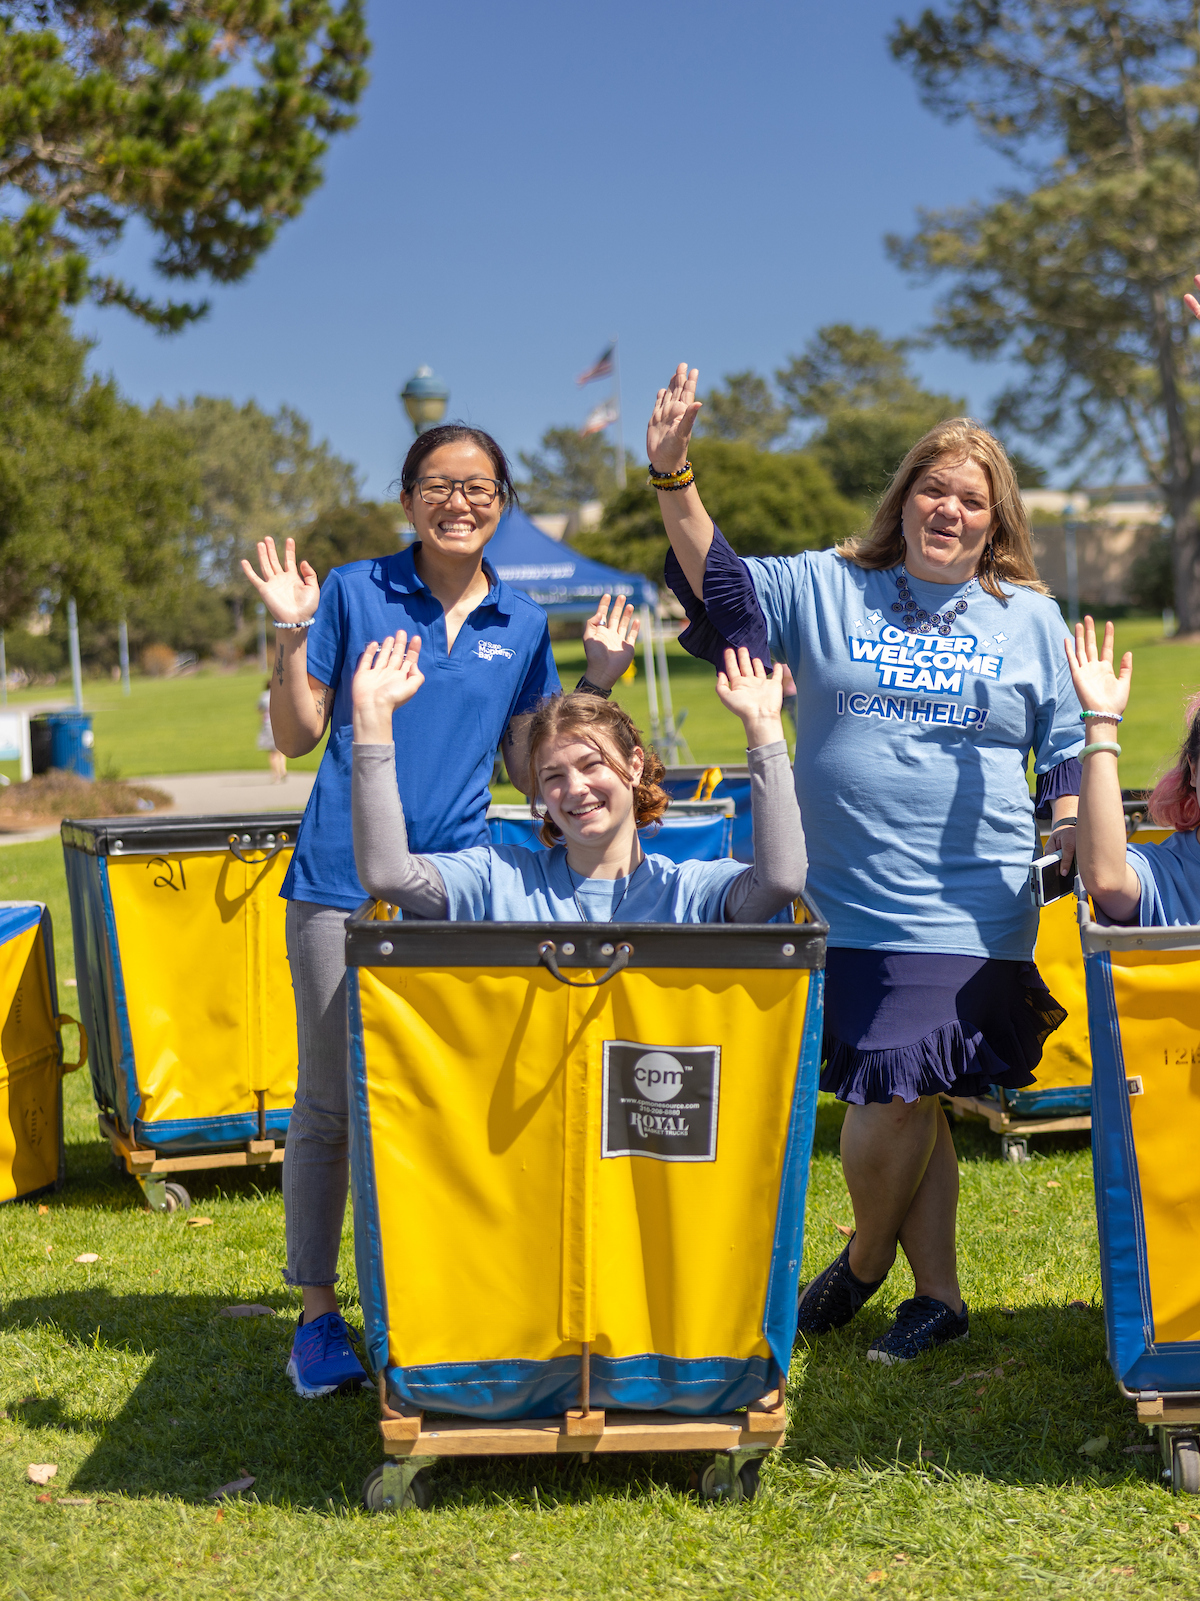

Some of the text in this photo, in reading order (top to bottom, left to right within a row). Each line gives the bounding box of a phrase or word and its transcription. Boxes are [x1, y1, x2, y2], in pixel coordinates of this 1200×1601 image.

[882, 625, 975, 654] OTTER
[851, 639, 998, 678] WELCOME
[880, 664, 962, 693] TEAM
[837, 692, 989, 731] I CAN HELP!
[146, 857, 187, 892] 21
[635, 1067, 683, 1087] cpm
[620, 1097, 700, 1109] www.cpmonesource.com
[630, 1112, 690, 1138] ROYAL
